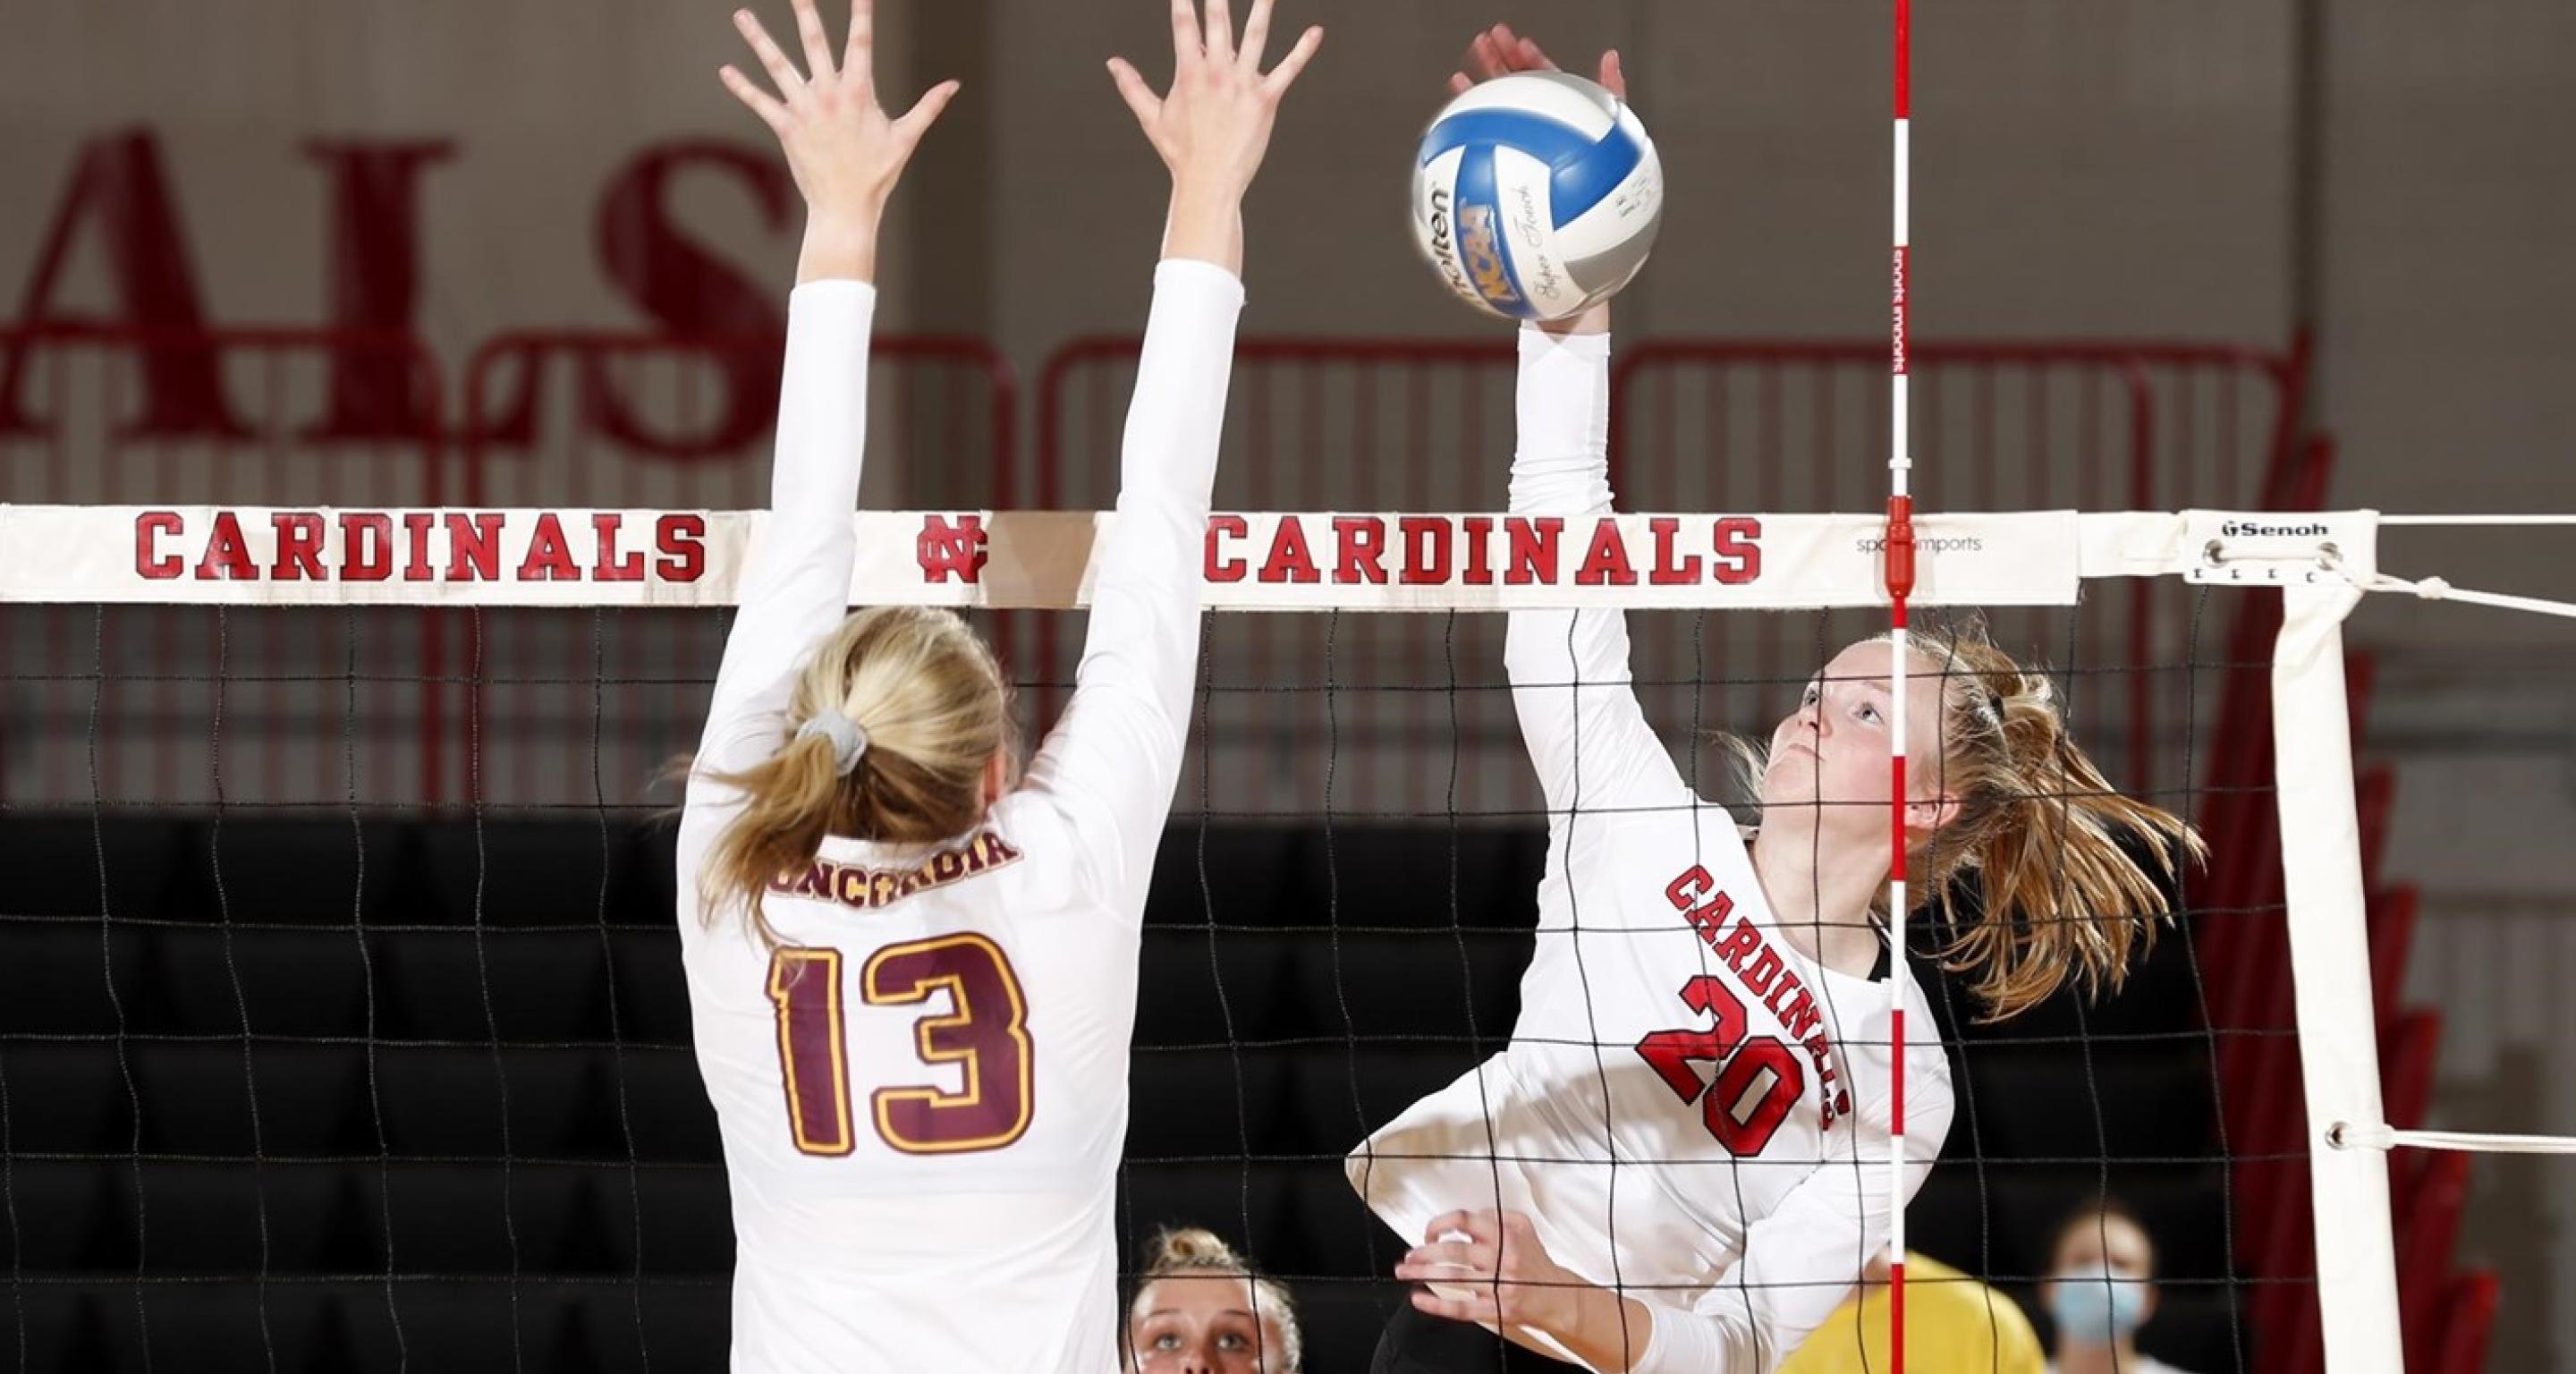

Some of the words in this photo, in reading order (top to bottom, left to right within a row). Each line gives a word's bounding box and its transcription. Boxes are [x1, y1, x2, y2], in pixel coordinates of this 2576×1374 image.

[1460, 204, 1521, 301] NCAA
[1893, 249, 1904, 303] sports
[1893, 306, 1904, 373] imports
[135, 513, 705, 582] CARDINALS
[1203, 515, 1762, 585] CARDINALS
[2241, 522, 2329, 537] Senoh
[764, 931, 1035, 1156] 13
[1634, 974, 1805, 1157] 20
